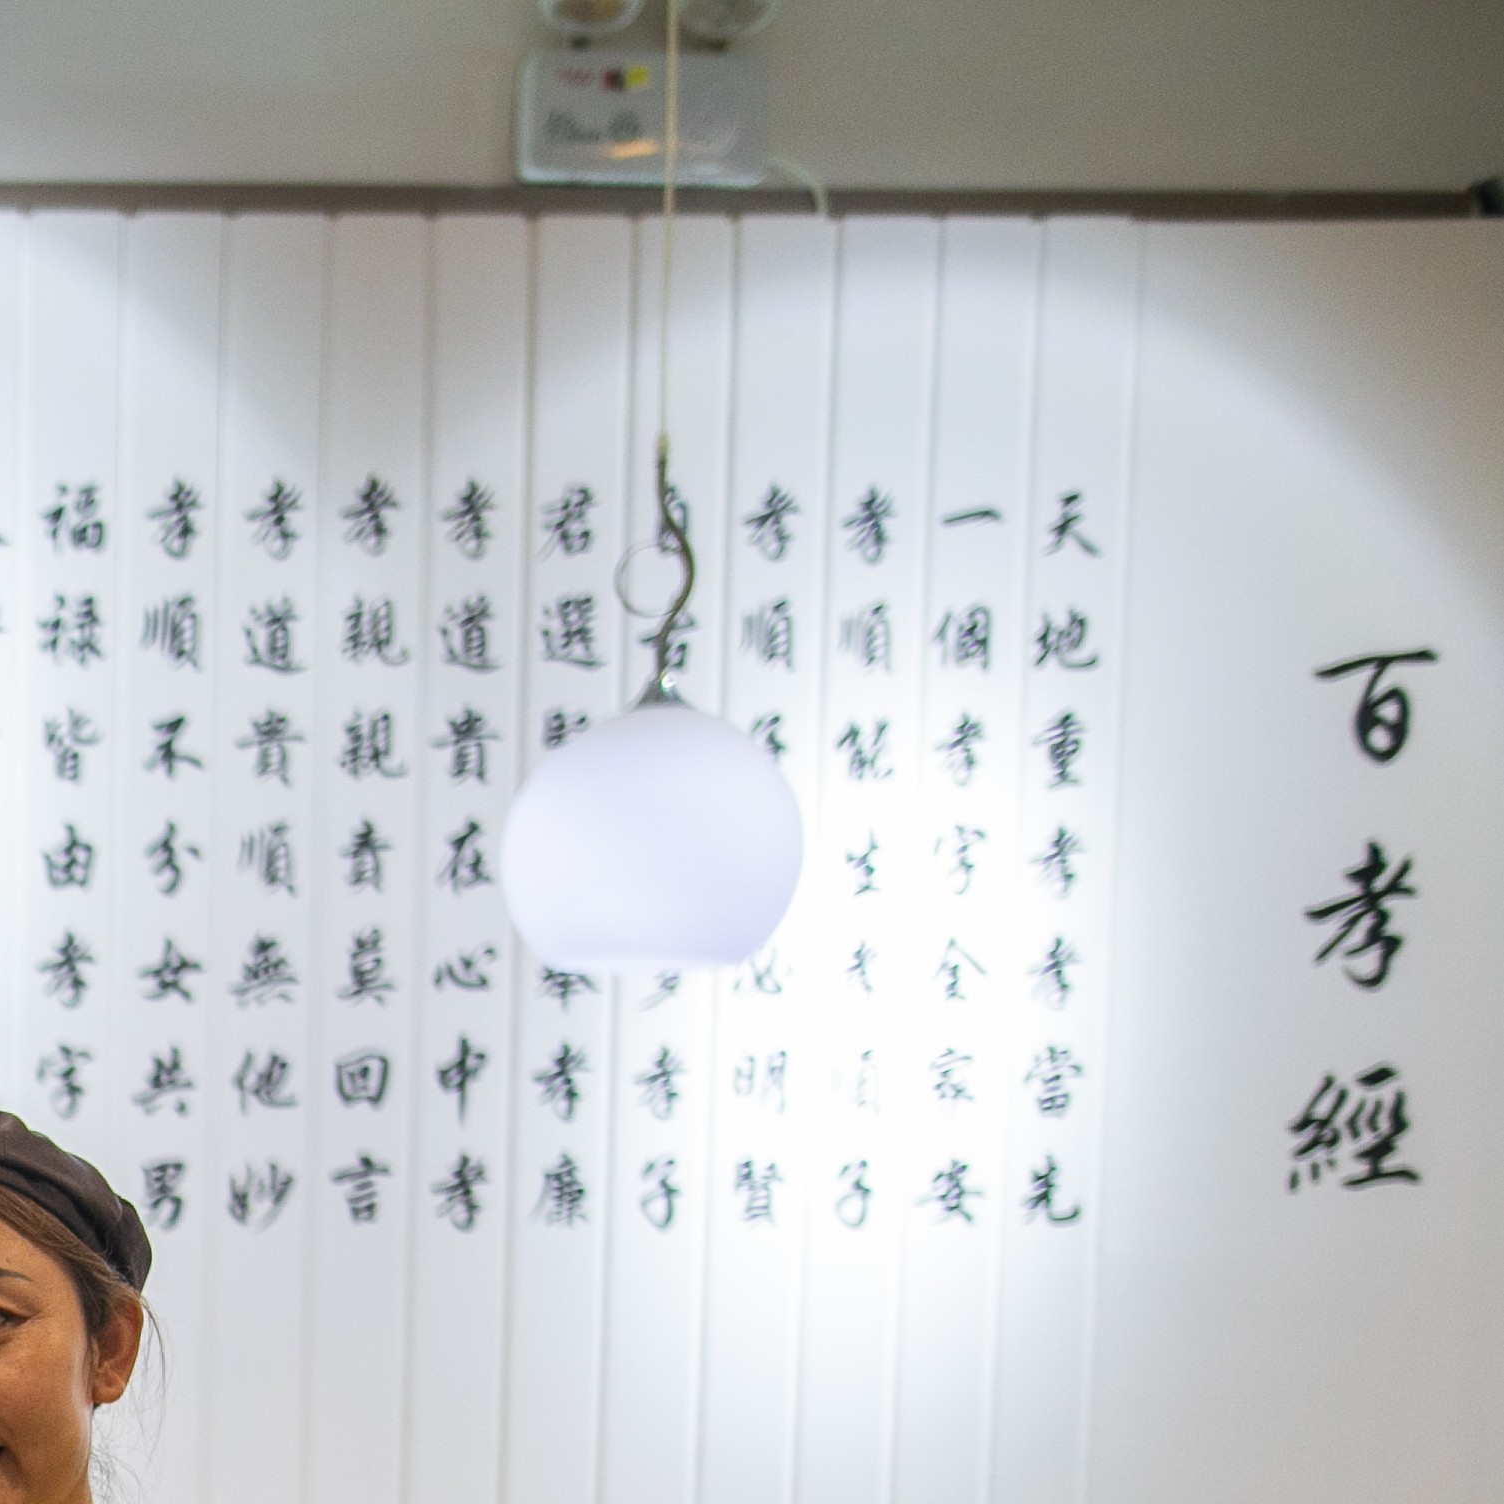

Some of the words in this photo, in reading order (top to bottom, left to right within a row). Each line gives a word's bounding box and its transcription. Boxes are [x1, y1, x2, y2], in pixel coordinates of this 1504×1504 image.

[430, 475, 502, 1234] 孝道貴在心中孝
[920, 503, 1005, 1228] 一個孝字全家安
[1023, 489, 1103, 1229] 天地重孝孝當先
[1285, 647, 1441, 1191] 百孝經
